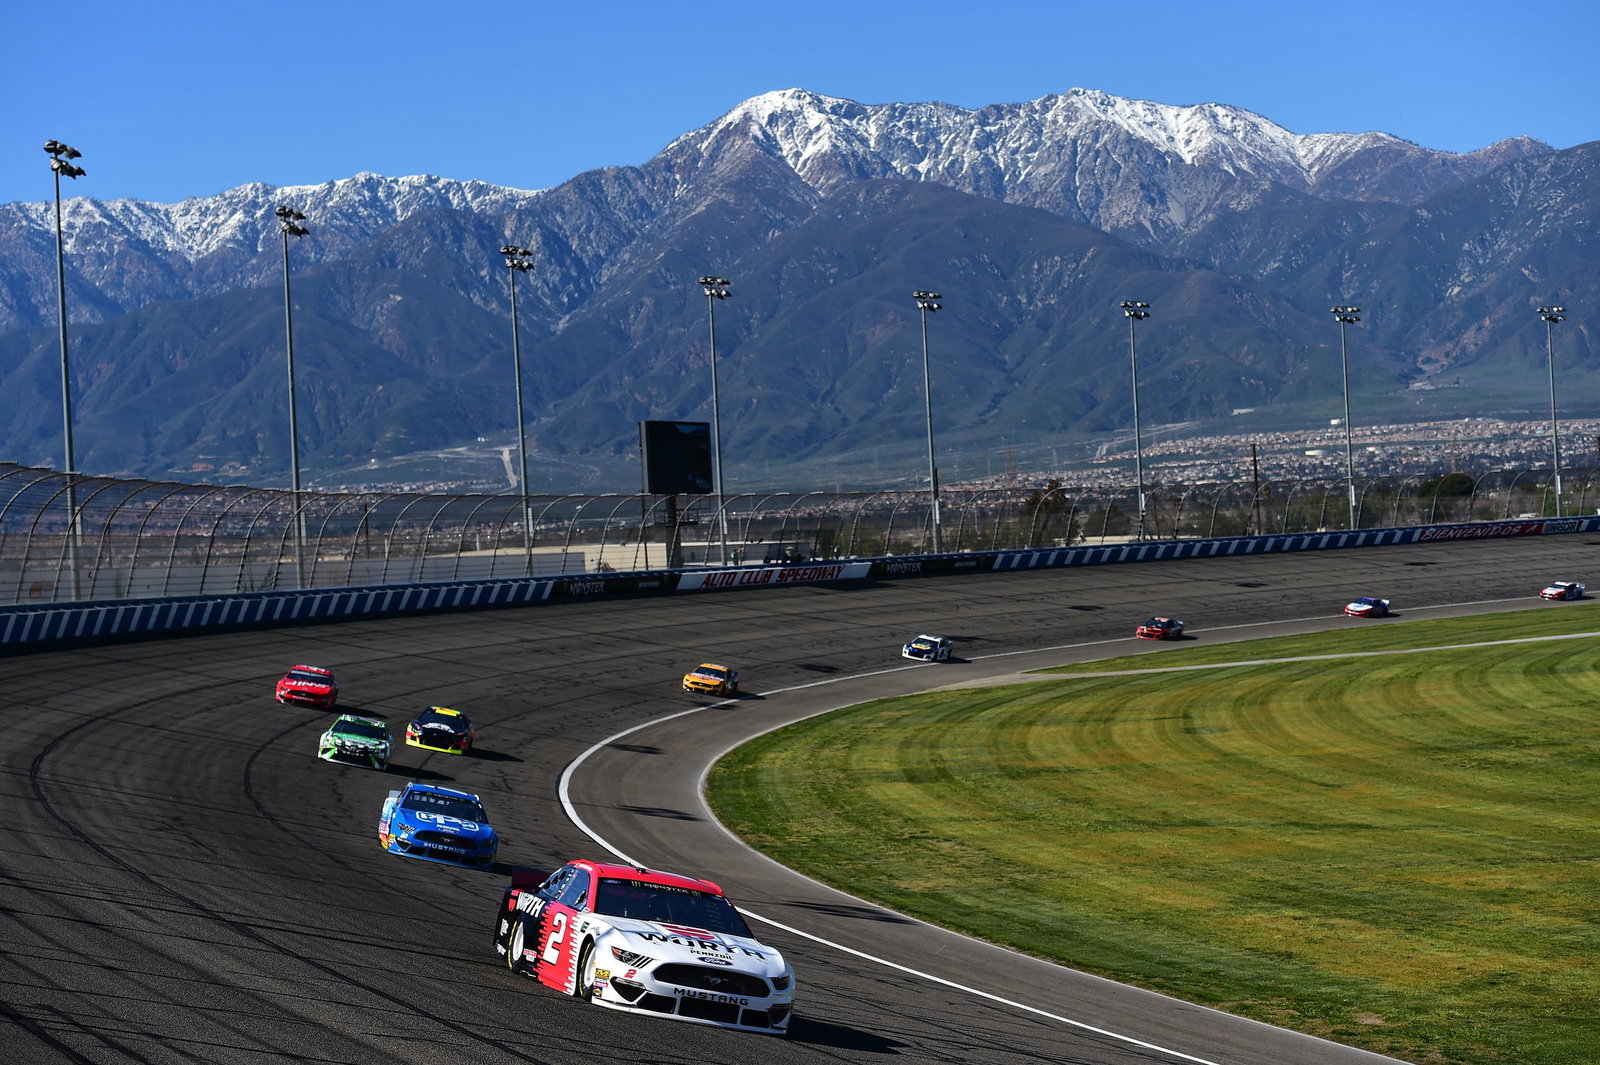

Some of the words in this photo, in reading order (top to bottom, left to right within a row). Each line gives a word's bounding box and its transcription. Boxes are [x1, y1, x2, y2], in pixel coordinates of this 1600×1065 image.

[1420, 525, 1520, 541] BIENVENIDOS
[885, 561, 922, 575] MONSTER
[701, 571, 738, 588] AUTO
[739, 569, 774, 585] CLUB
[776, 565, 845, 583] SPEEDWAY
[569, 581, 605, 595] MONSTER
[644, 882, 689, 895] MONSTER
[542, 911, 568, 966] 2
[690, 949, 734, 960] PENNZOIL
[624, 969, 637, 978] 2
[673, 987, 749, 1006] MUSTANG
